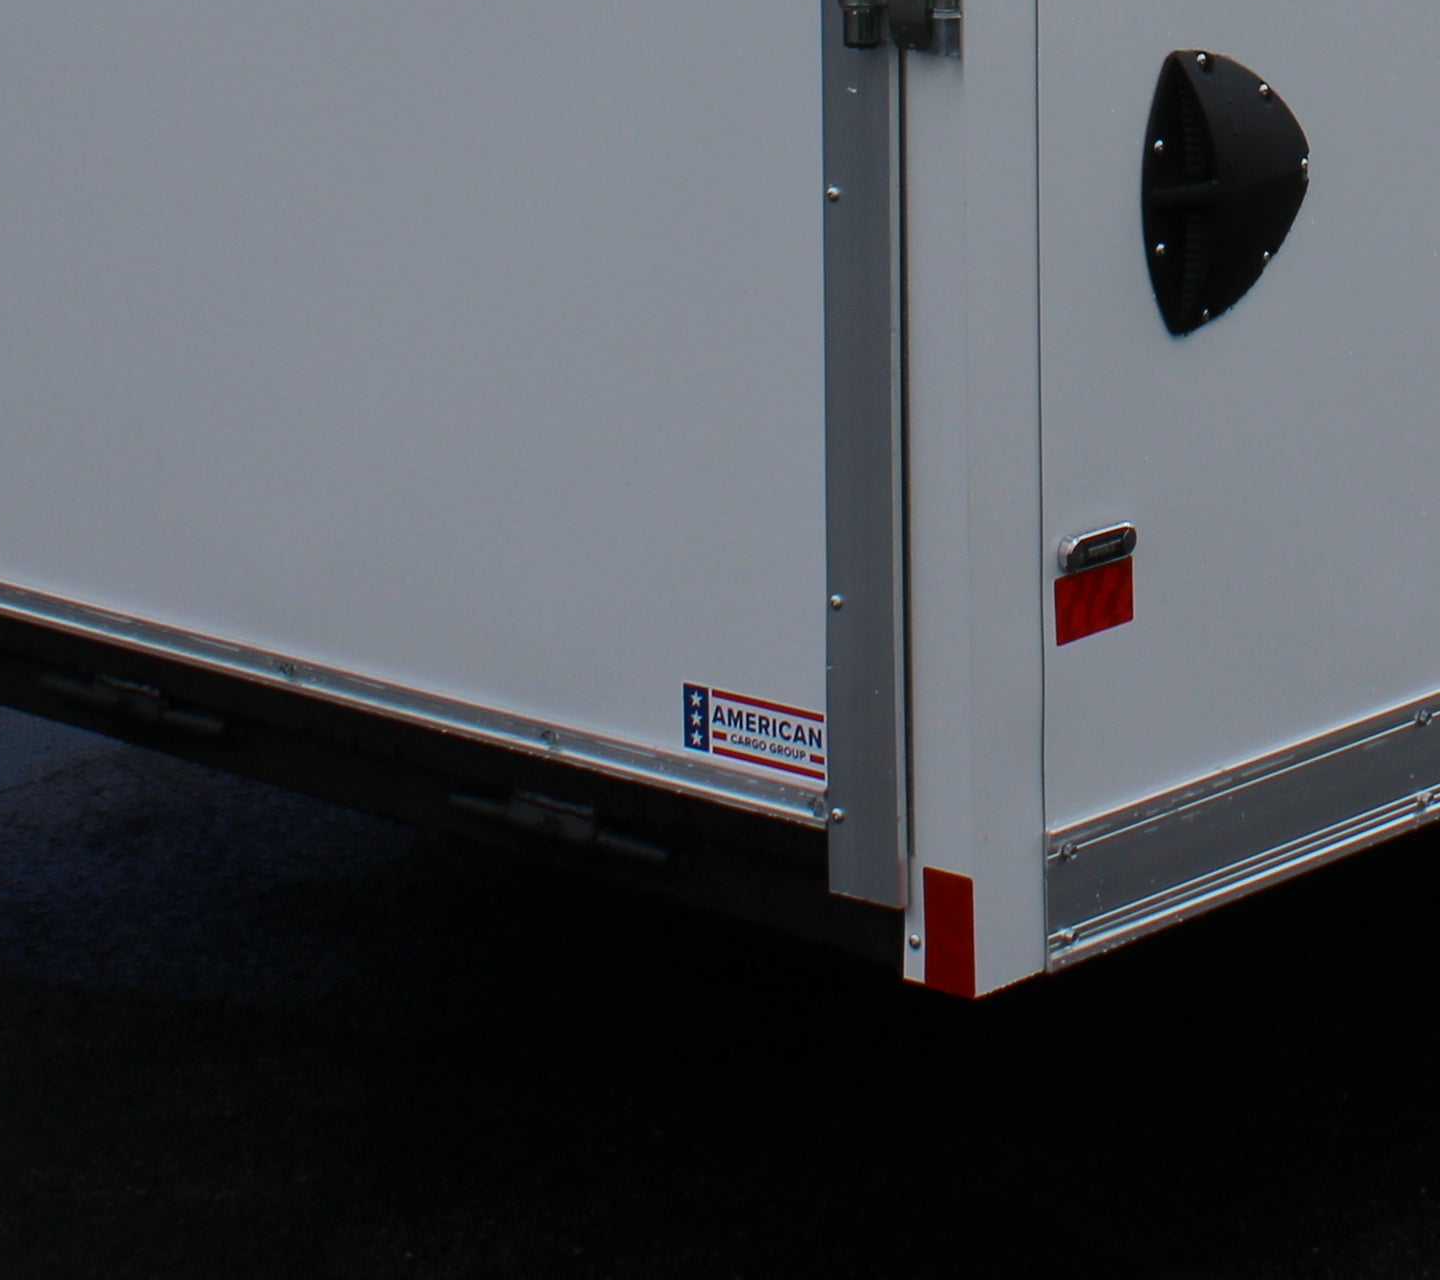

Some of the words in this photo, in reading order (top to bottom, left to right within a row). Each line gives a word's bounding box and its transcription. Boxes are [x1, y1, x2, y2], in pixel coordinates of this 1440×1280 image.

[712, 704, 823, 749] AMERICAN
[730, 733, 768, 752] CARGO
[769, 743, 807, 761] GROUP
